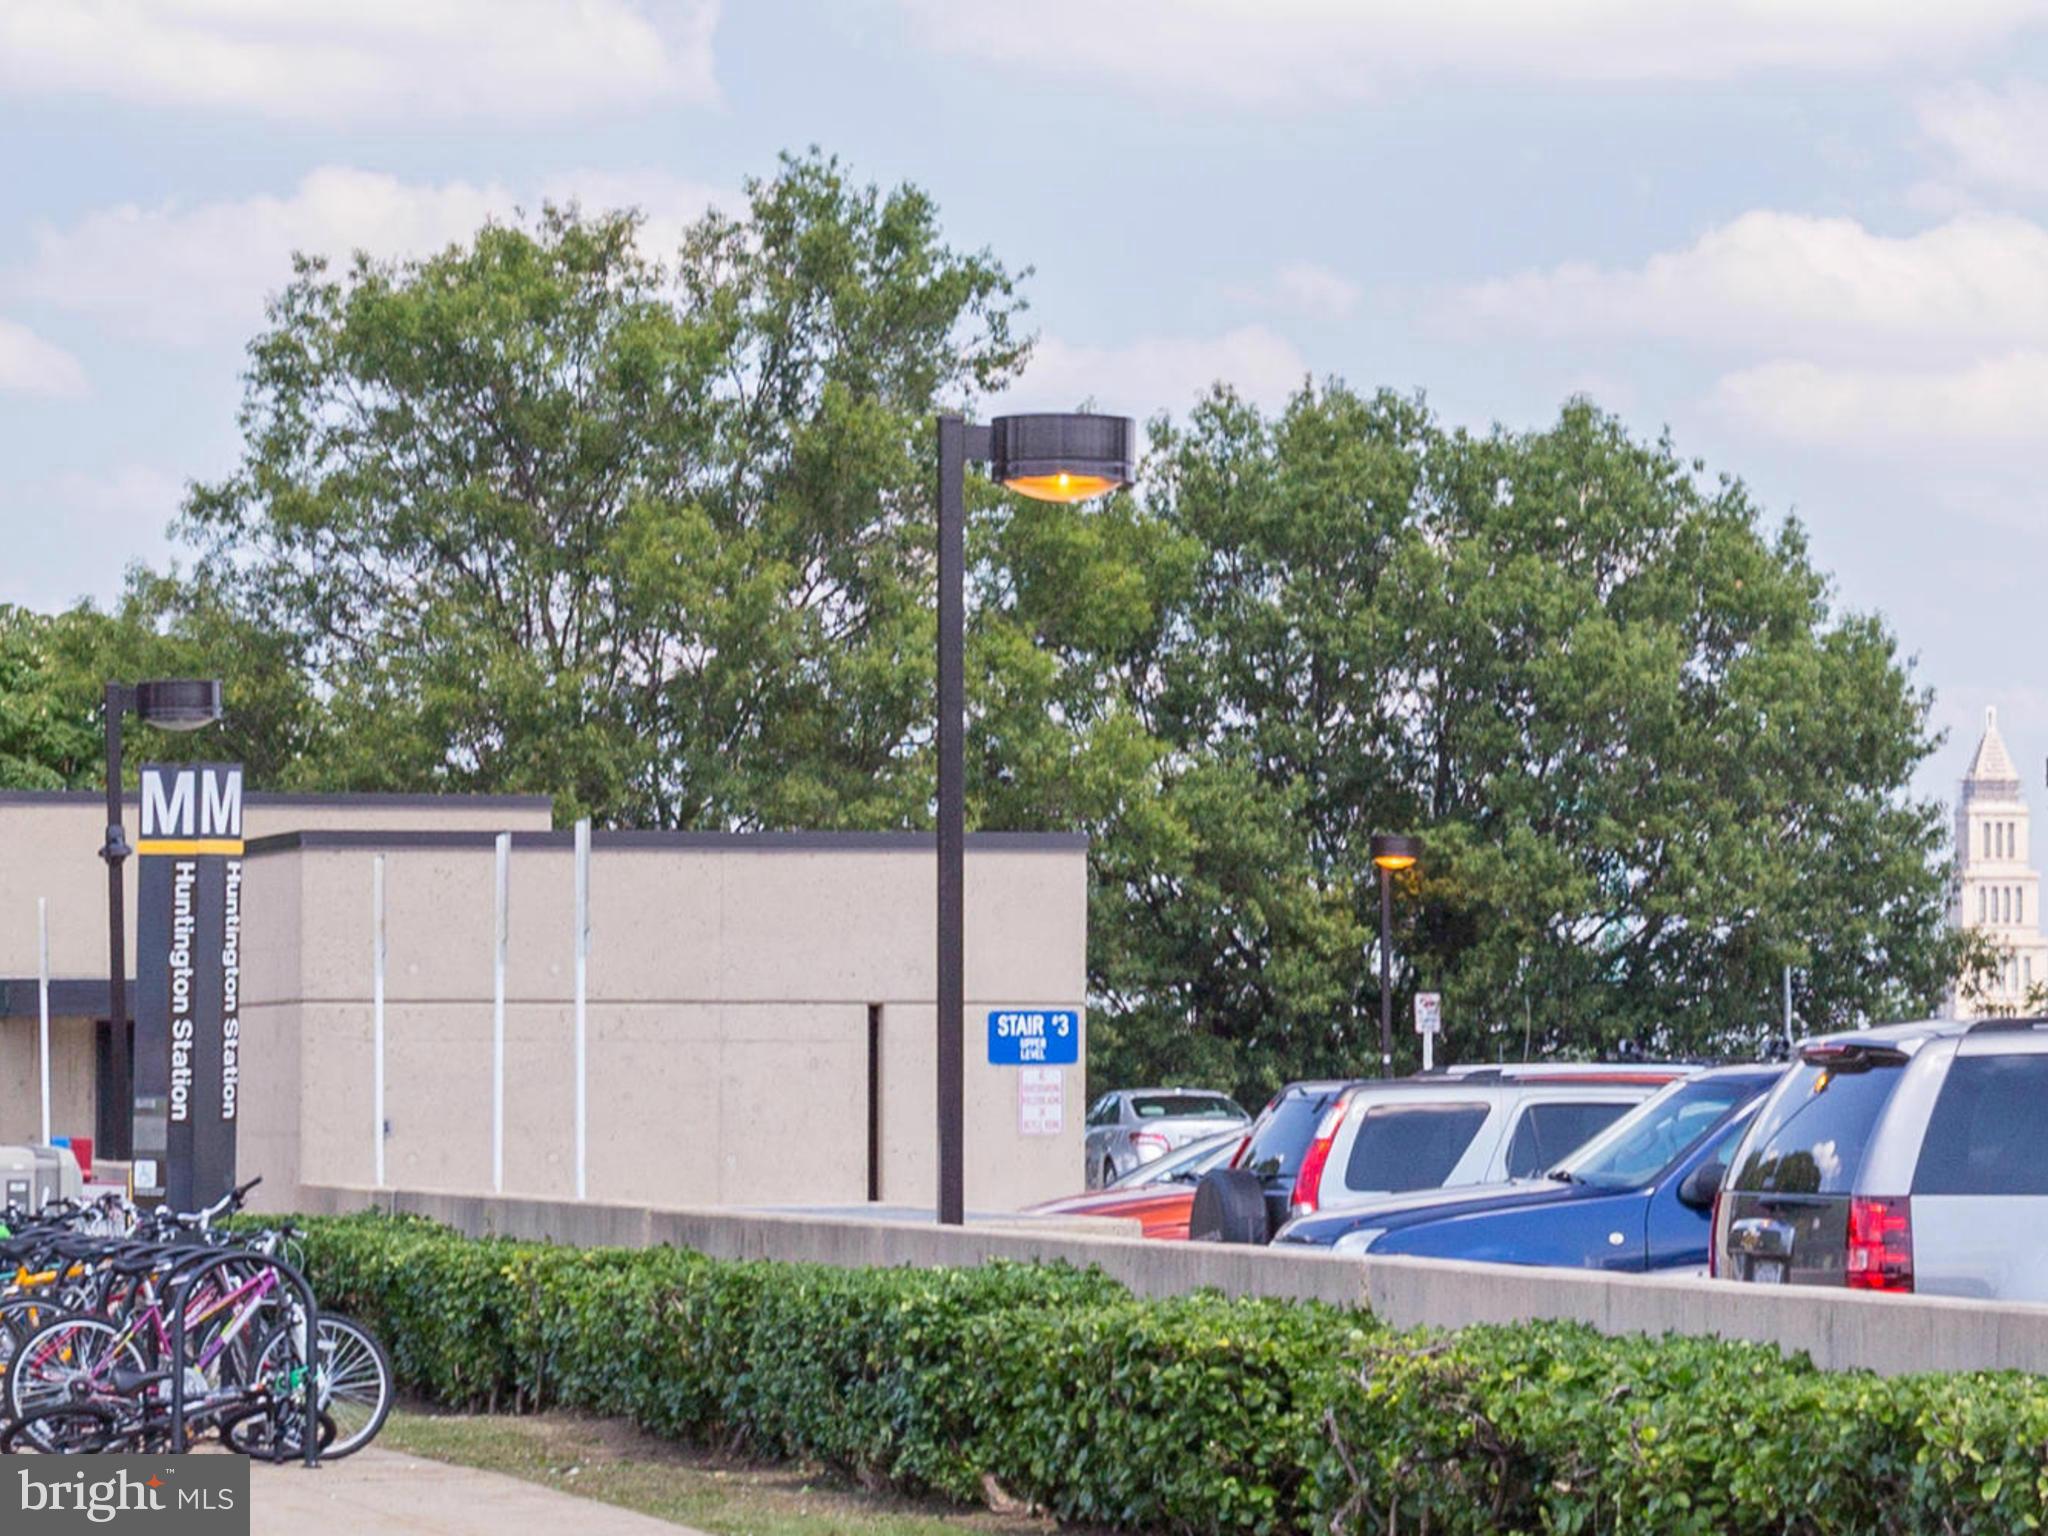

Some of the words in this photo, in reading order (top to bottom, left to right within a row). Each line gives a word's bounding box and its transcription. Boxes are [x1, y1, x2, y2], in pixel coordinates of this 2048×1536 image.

[142, 770, 195, 835] M
[201, 769, 241, 835] M
[169, 861, 195, 1013] Huntington
[222, 861, 240, 1012] Huntington
[171, 1019, 193, 1121] Station
[222, 1018, 239, 1119] Station
[997, 1014, 1044, 1037] STAIR
